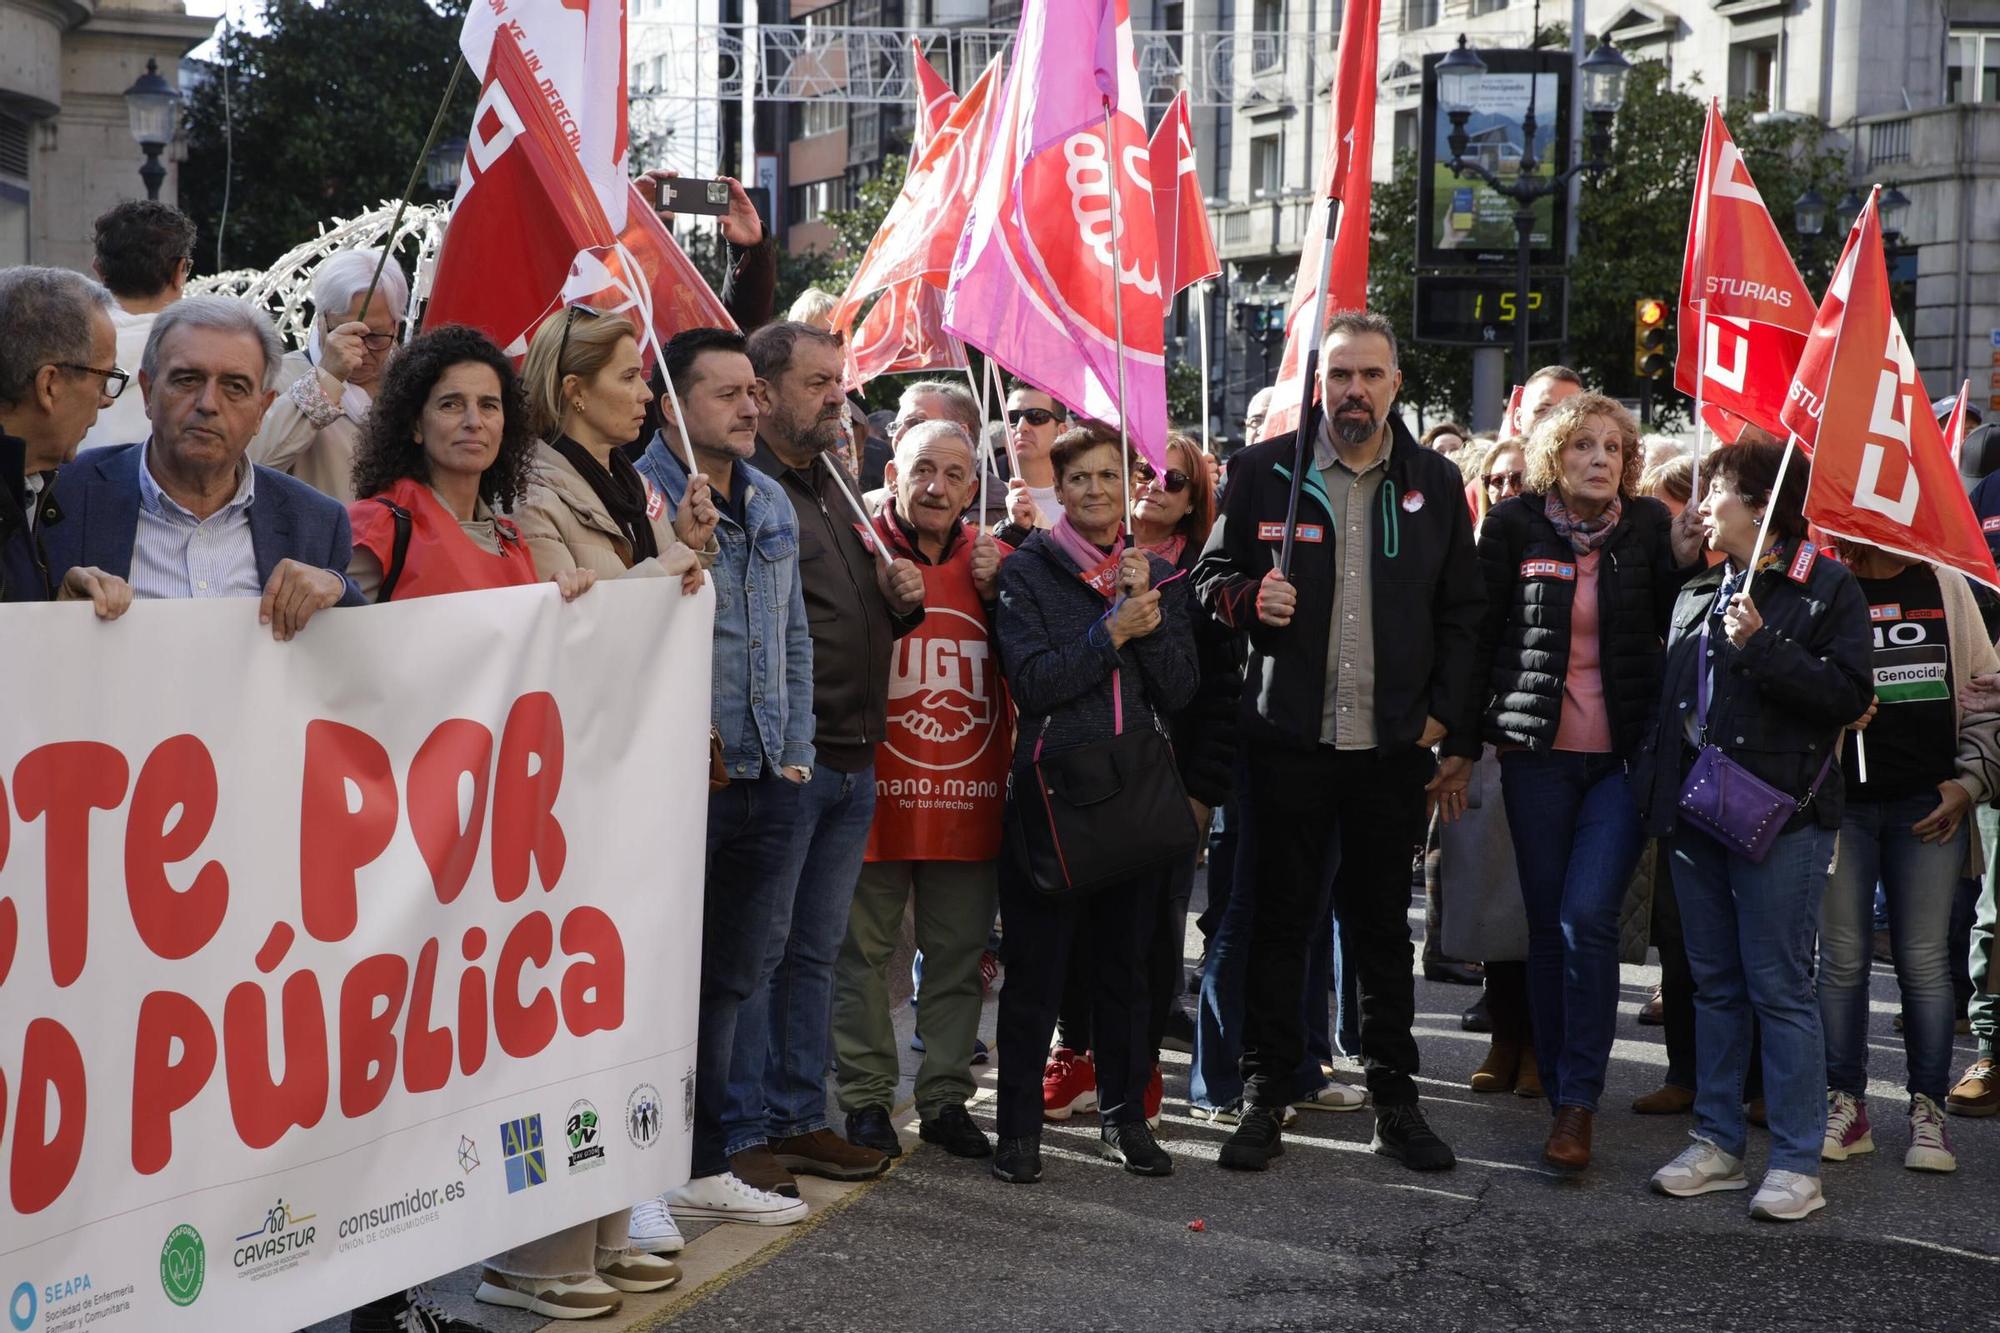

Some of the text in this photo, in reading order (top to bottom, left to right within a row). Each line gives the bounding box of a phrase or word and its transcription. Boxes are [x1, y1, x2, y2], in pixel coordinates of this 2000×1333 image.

[1705, 275, 1793, 308] STURIAS
[1261, 526, 1302, 537] CCO
[888, 638, 990, 700] UGT
[1877, 666, 1945, 682] Genocidio
[934, 784, 940, 794] a
[944, 778, 998, 798] mano
[900, 799, 974, 810] Por tus derechos
[0, 692, 567, 988] Te POR
[339, 1181, 465, 1238] consumidor.es
[367, 1232, 376, 1243] DE
[380, 1211, 440, 1239] CONSUMIDORES
[234, 1226, 316, 1267] CAVASTUR
[45, 1273, 92, 1304] SEAPA
[45, 1301, 81, 1323] Sociedad
[83, 1299, 92, 1309] de
[85, 1300, 131, 1324] Comunitaria
